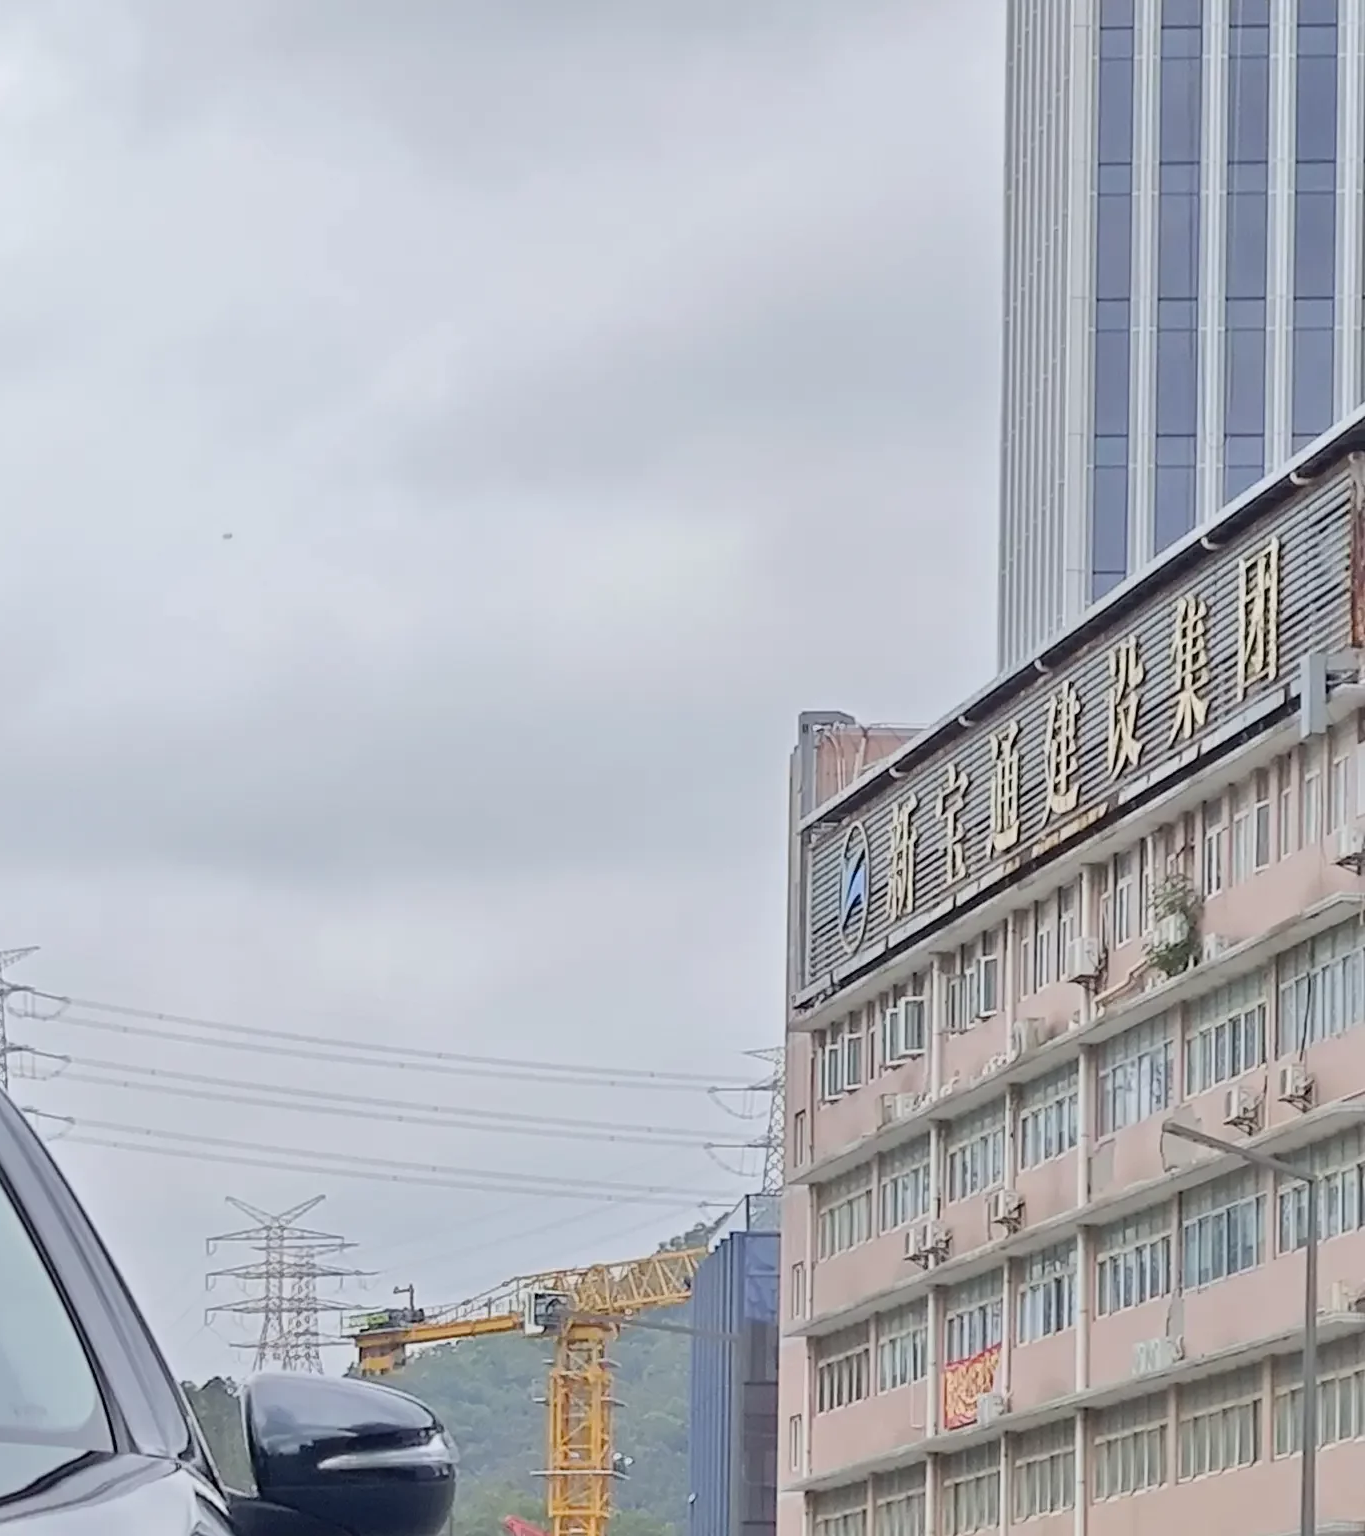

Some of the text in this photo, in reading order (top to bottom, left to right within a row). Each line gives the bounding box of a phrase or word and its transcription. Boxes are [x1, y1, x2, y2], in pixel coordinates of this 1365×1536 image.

[886, 535, 1281, 923] 新宝通建设集团
